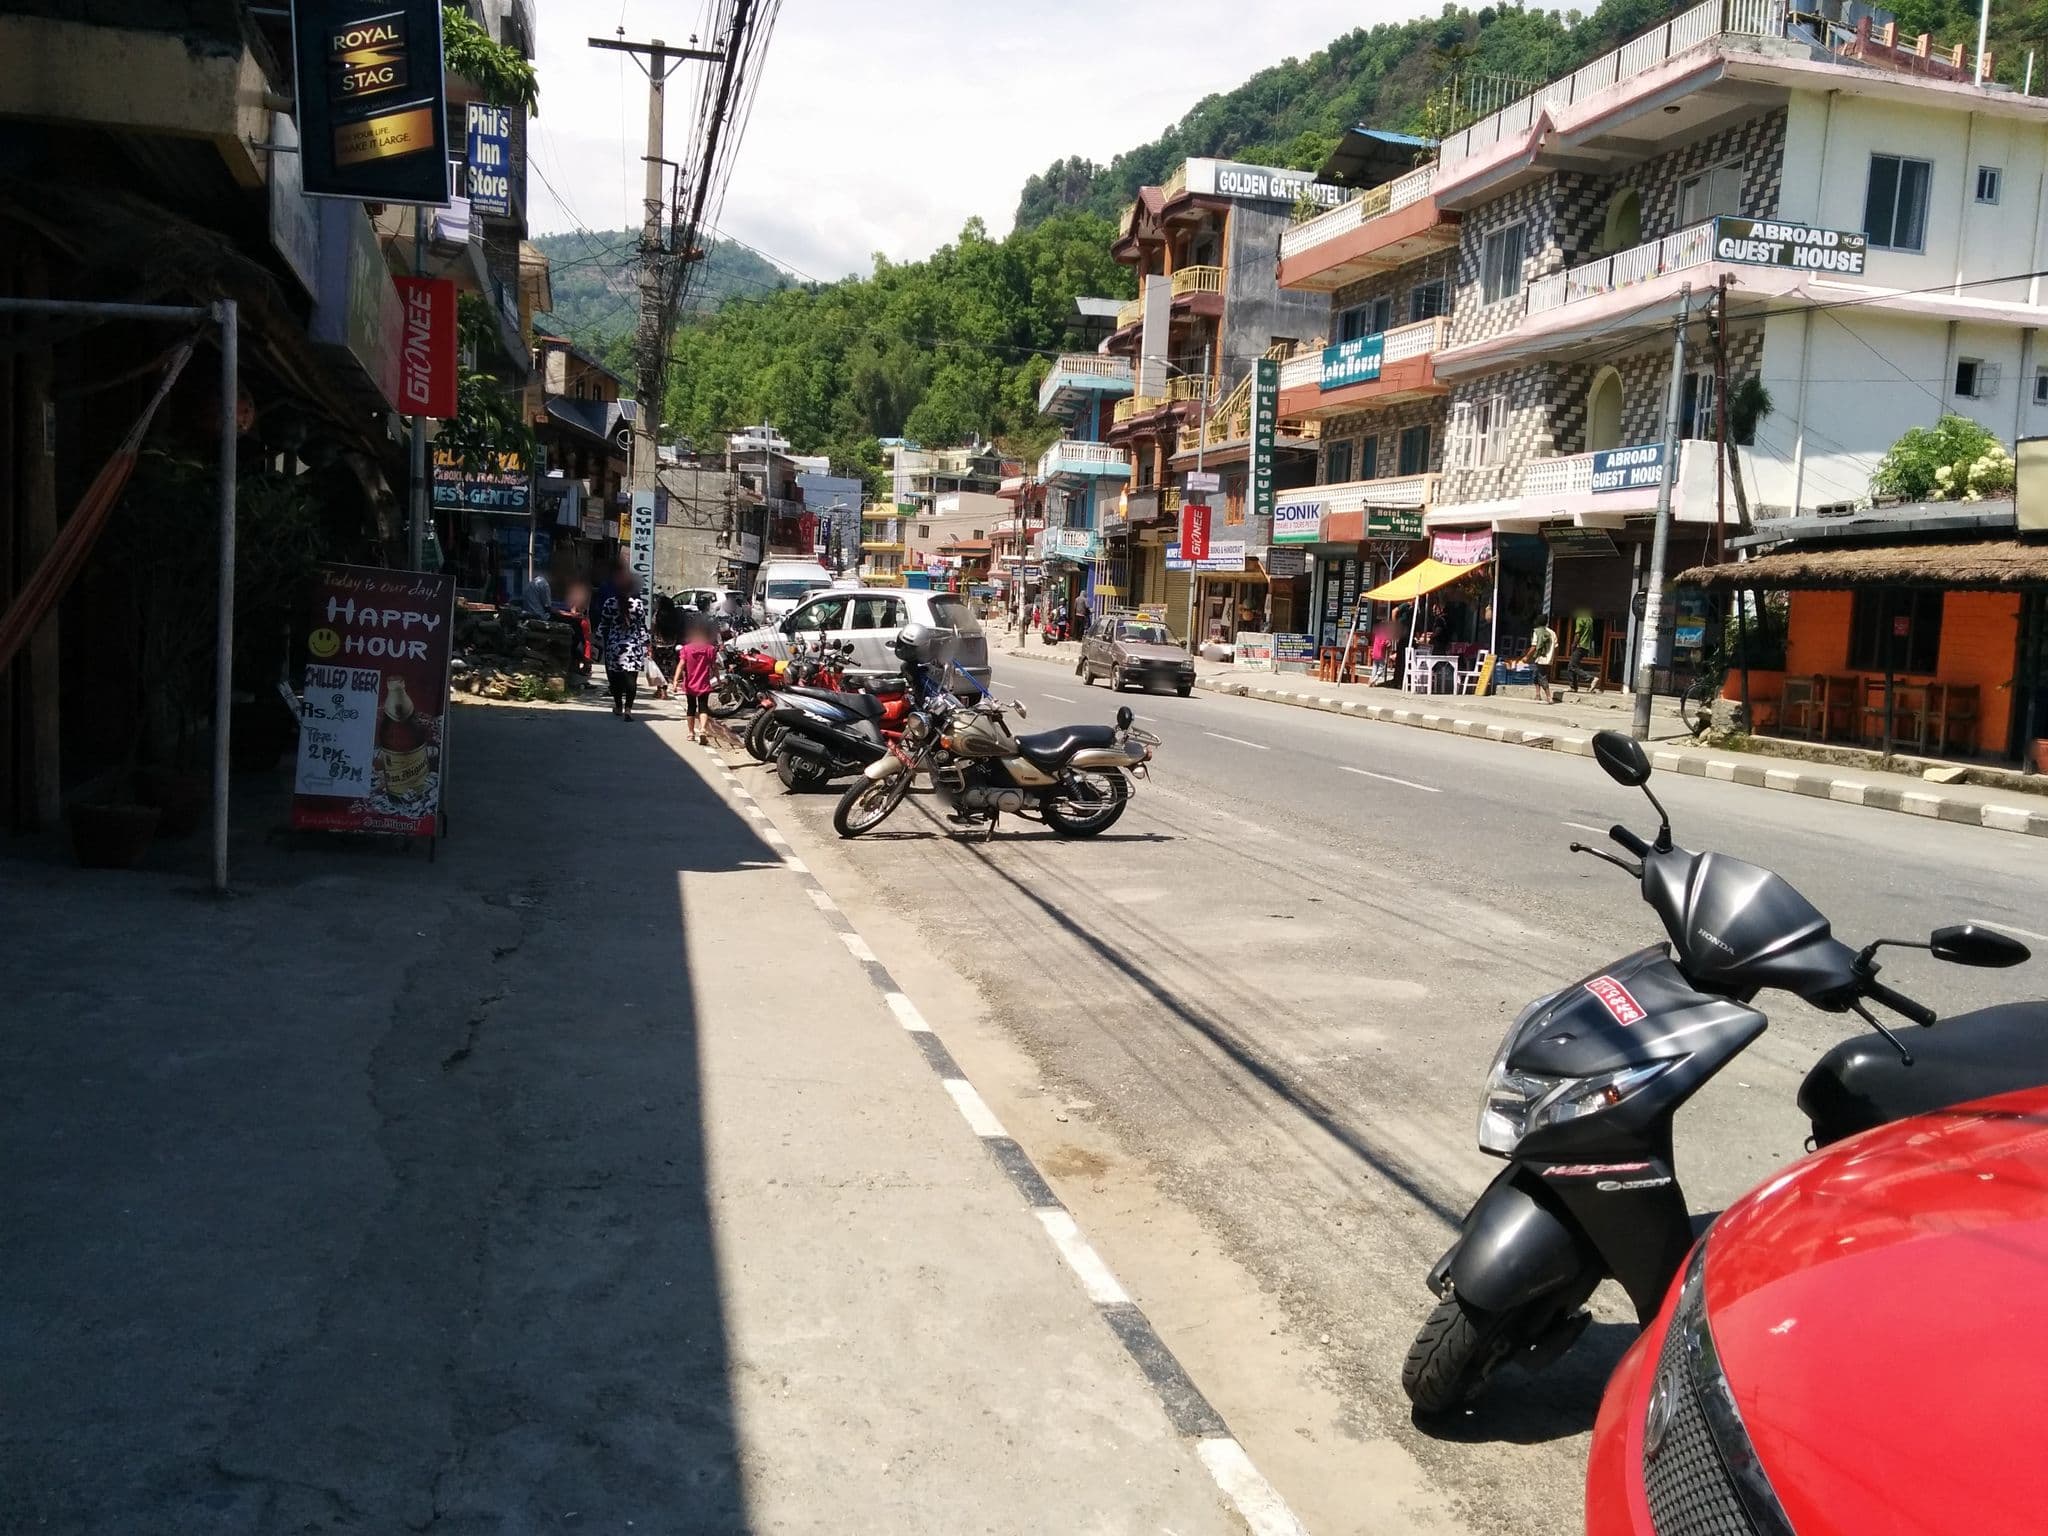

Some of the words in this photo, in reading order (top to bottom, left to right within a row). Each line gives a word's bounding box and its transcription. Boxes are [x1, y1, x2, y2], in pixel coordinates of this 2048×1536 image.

[333, 25, 399, 50] ROYAL
[342, 67, 394, 91] STAG
[469, 105, 509, 138] Phil's
[370, 139, 377, 149] IT
[477, 135, 500, 165] Inn
[468, 166, 508, 197] Store
[1219, 171, 1268, 196] GOLDEN
[1270, 177, 1302, 200] GATE
[1303, 181, 1341, 205] HOTEL
[1749, 222, 1839, 247] ABROAD
[1718, 237, 1784, 263] GUEST
[1793, 246, 1863, 272] HOUSE
[1340, 339, 1362, 358] Hotel
[1346, 353, 1381, 377] House
[1606, 447, 1658, 468] ABROAD
[1593, 469, 1626, 488] GUEST
[1630, 464, 1663, 485] HOUS
[469, 488, 525, 506] GENTS
[635, 507, 652, 535] GYM
[1276, 504, 1320, 521] SONIK
[323, 570, 362, 592] Today
[365, 577, 377, 591] is
[380, 582, 408, 593] our
[326, 596, 441, 632] HAPPY
[345, 634, 428, 661] HOUR
[304, 667, 348, 690] CHILLED
[351, 670, 379, 694] BEER
[1697, 927, 1736, 955] HONDA
